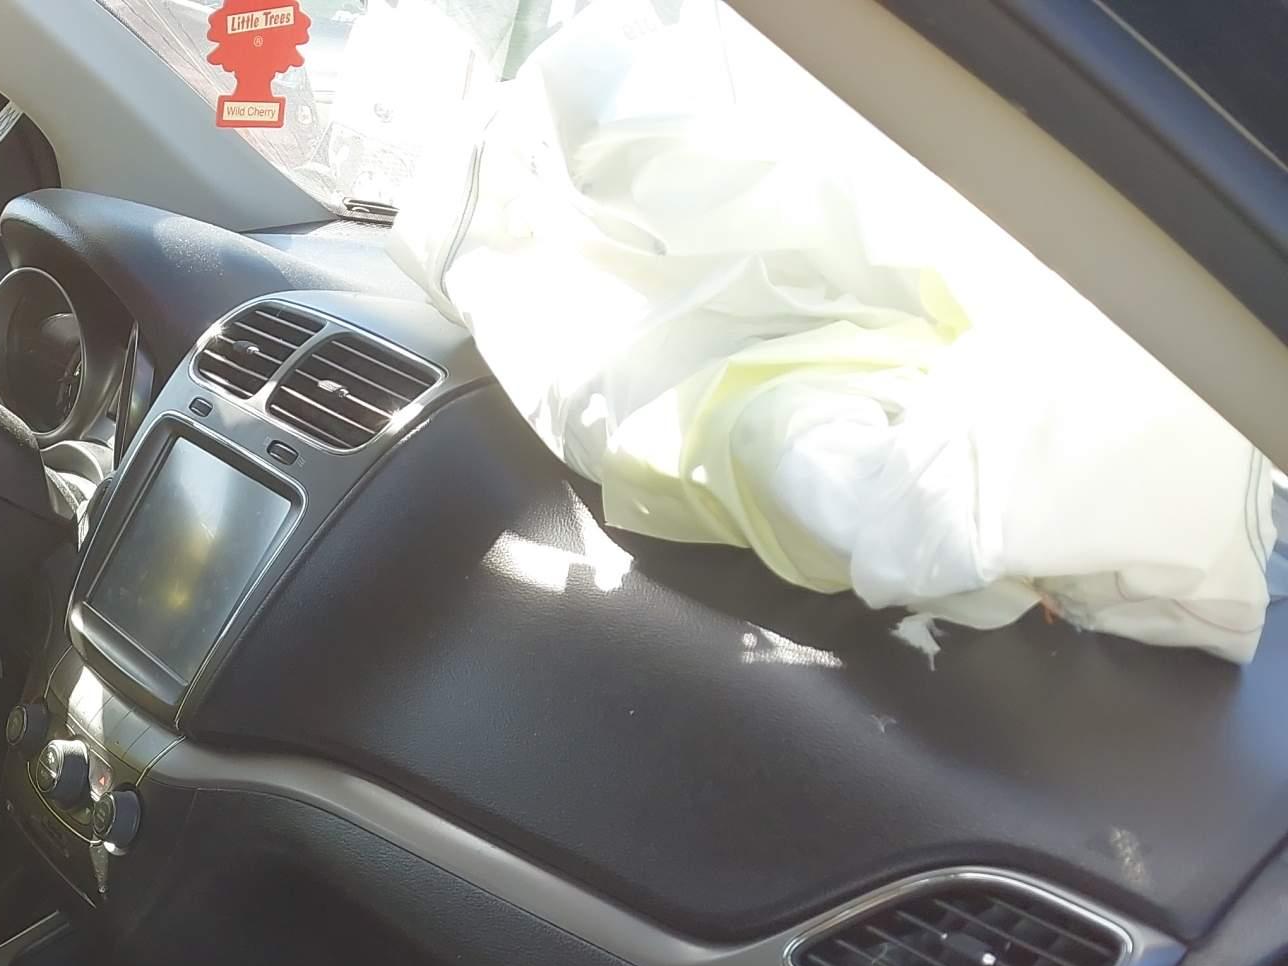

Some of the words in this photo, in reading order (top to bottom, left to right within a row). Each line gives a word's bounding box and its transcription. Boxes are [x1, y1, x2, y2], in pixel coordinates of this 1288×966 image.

[231, 13, 260, 31] Little
[263, 11, 291, 26] Trees
[226, 104, 245, 116] Wild
[247, 105, 276, 119] Cherry
